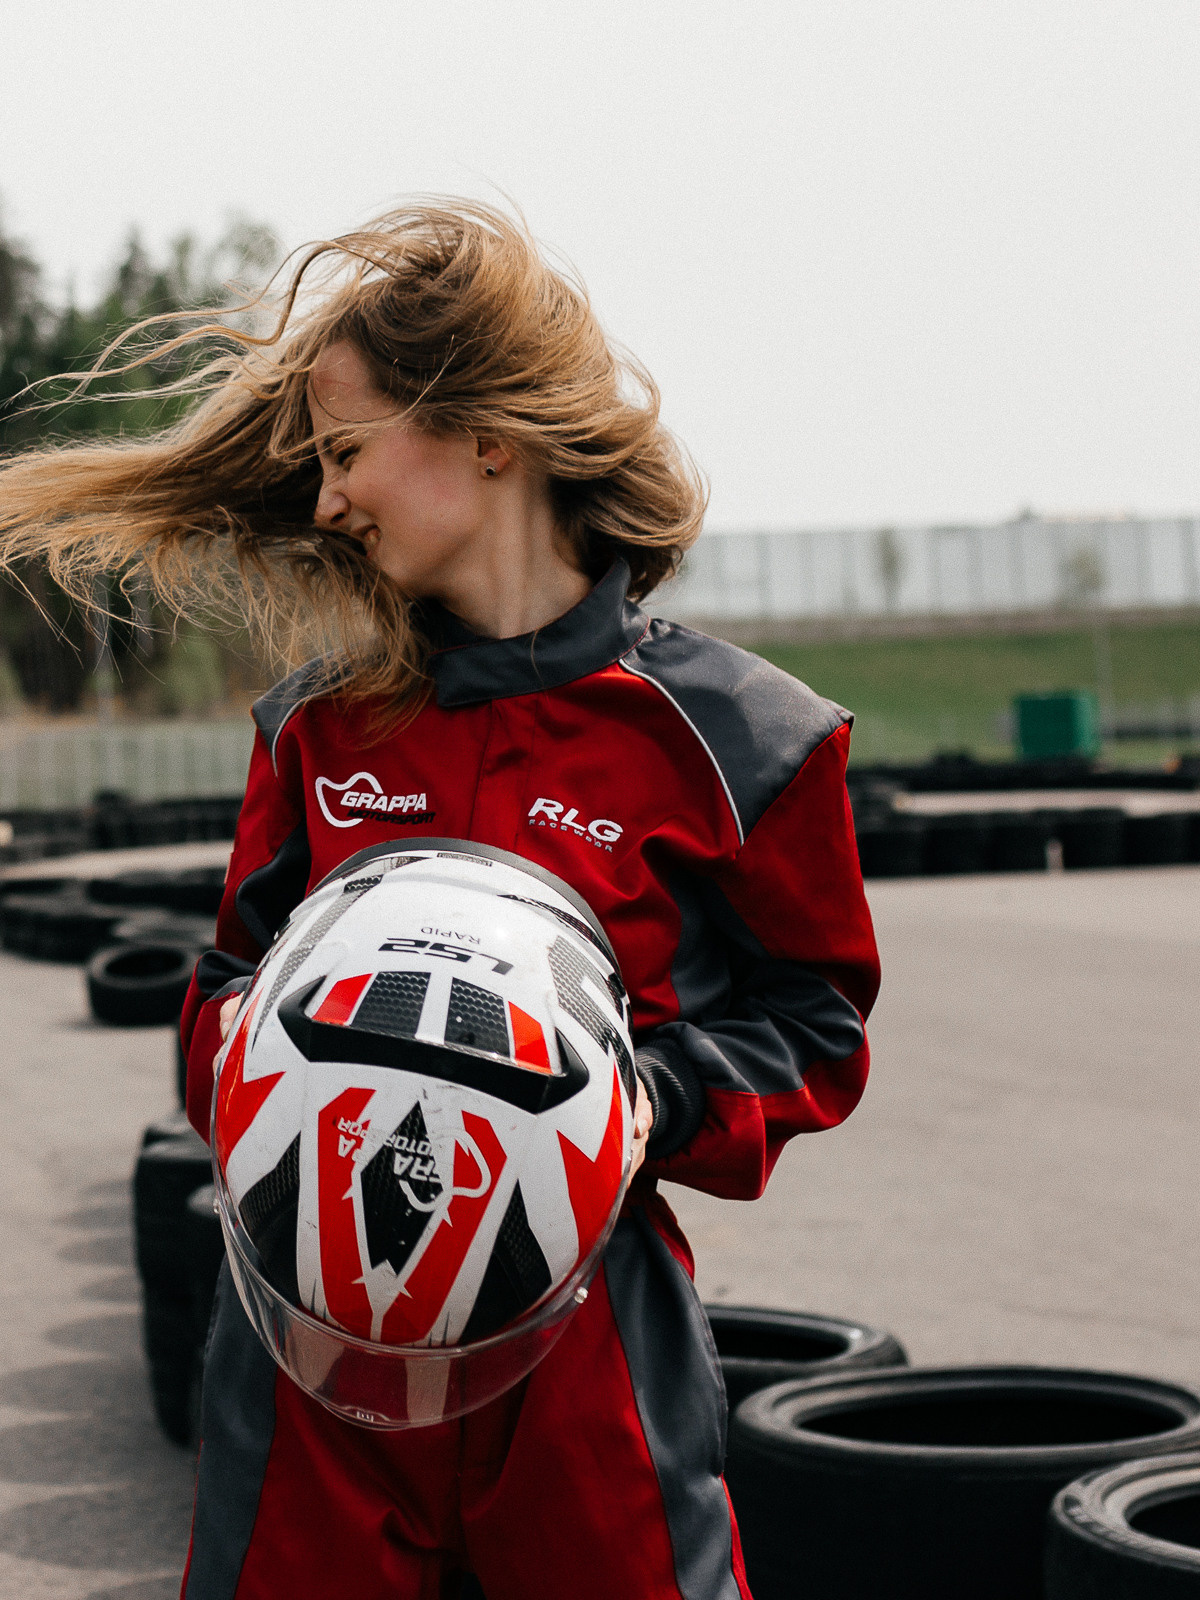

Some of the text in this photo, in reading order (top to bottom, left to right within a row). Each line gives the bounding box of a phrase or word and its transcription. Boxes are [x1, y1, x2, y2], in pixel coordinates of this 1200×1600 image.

[340, 791, 427, 813] GRAPPA
[346, 808, 436, 825] MOTORSPORT
[528, 797, 623, 842] RLG
[420, 926, 481, 945] RAPID
[378, 937, 514, 976] LS2
